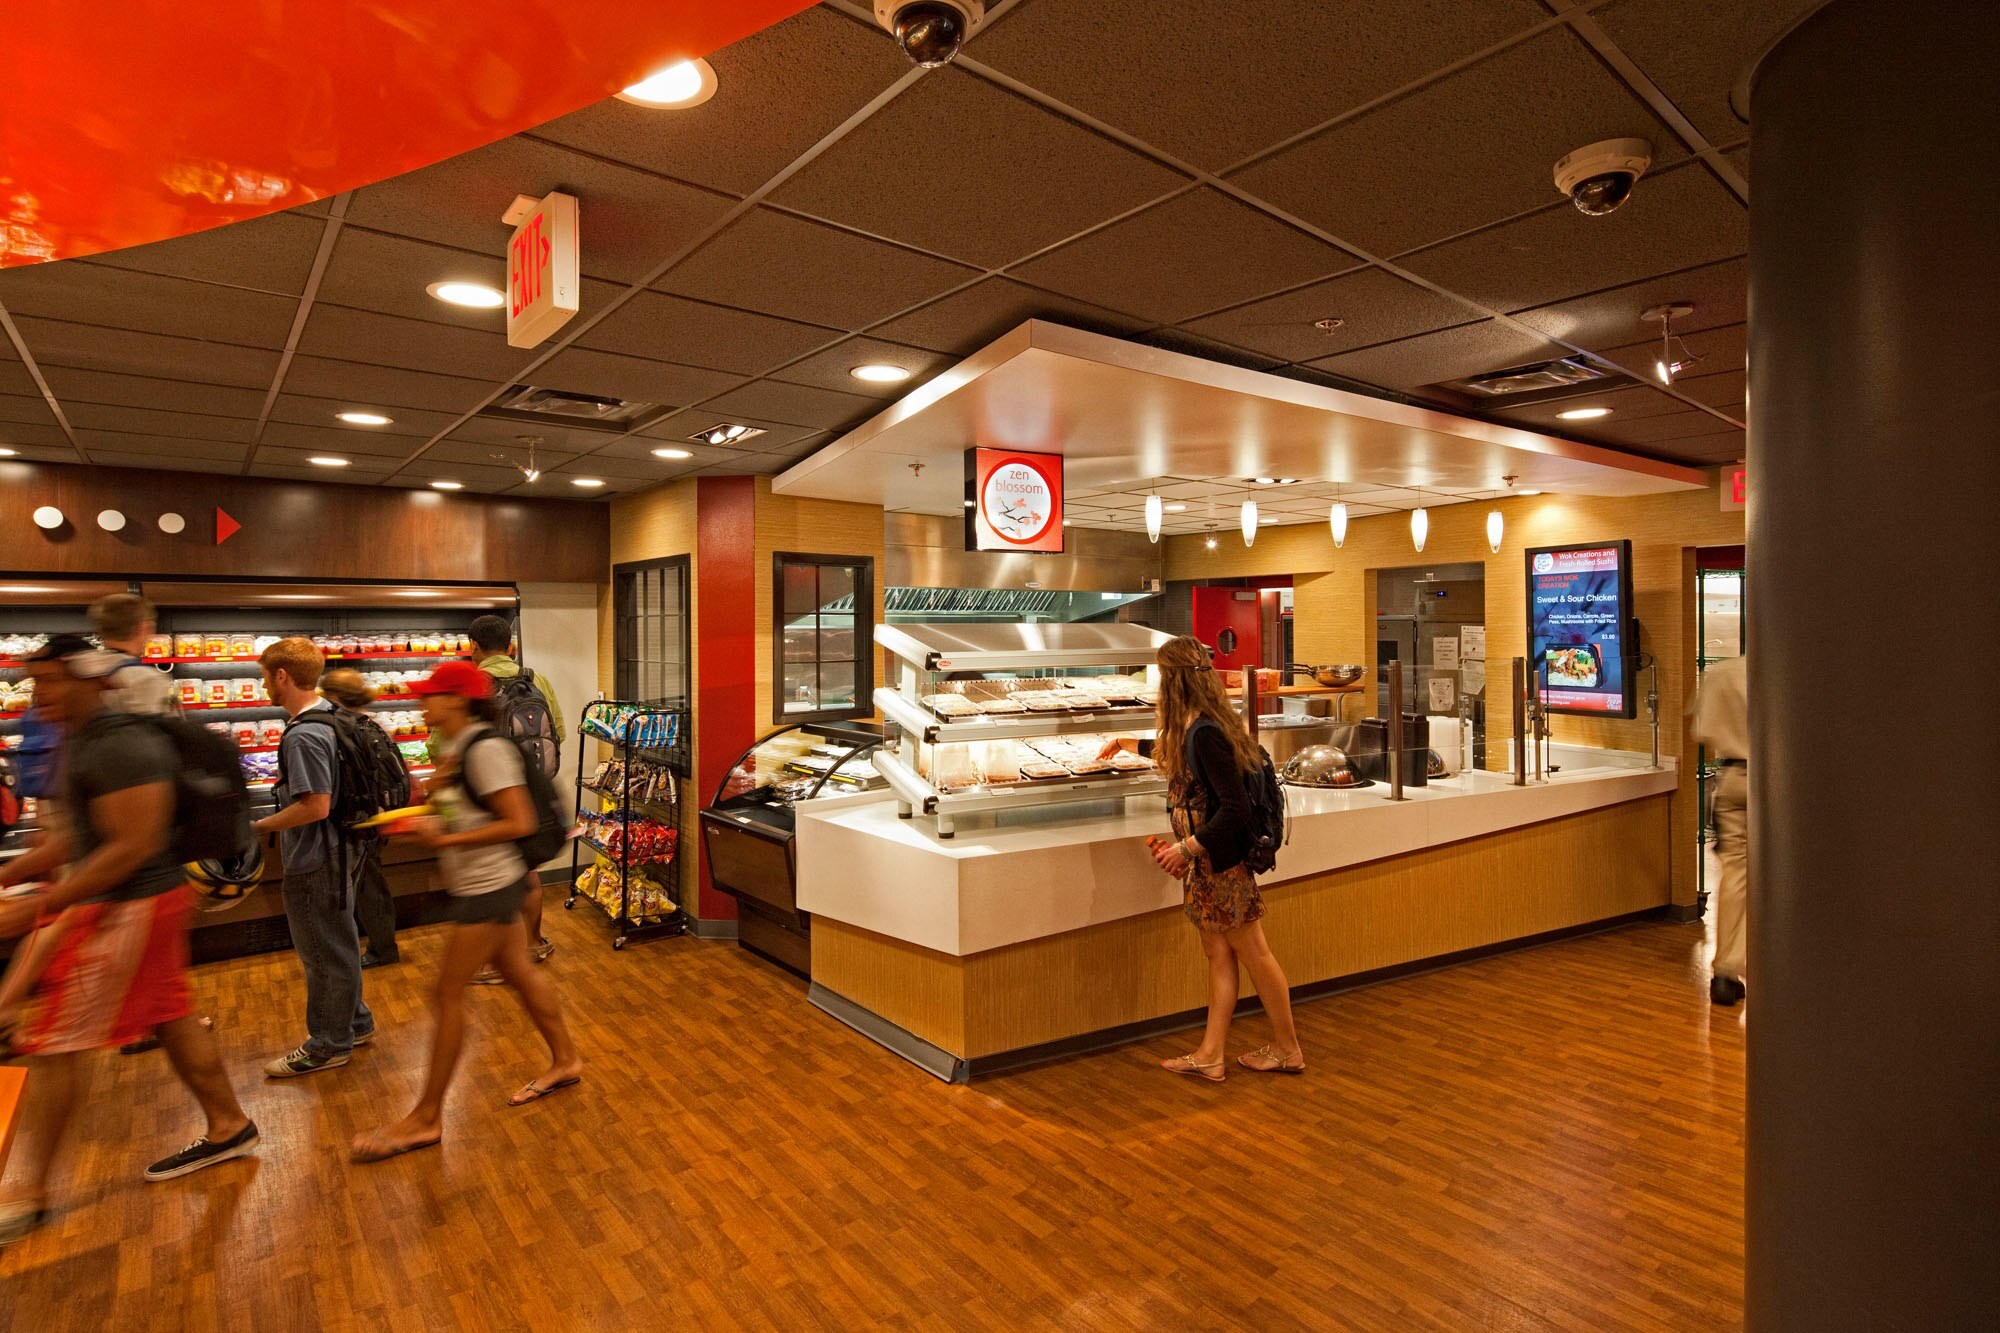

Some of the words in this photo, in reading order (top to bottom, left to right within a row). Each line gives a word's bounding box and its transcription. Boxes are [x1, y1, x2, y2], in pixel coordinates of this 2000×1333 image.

[512, 212, 543, 319] EXIT
[1010, 470, 1029, 480] zen
[995, 479, 1043, 495] blossom
[1573, 551, 1601, 559] Creations
[1536, 596, 1559, 604] Sweet
[1586, 594, 1617, 602] Chicken
